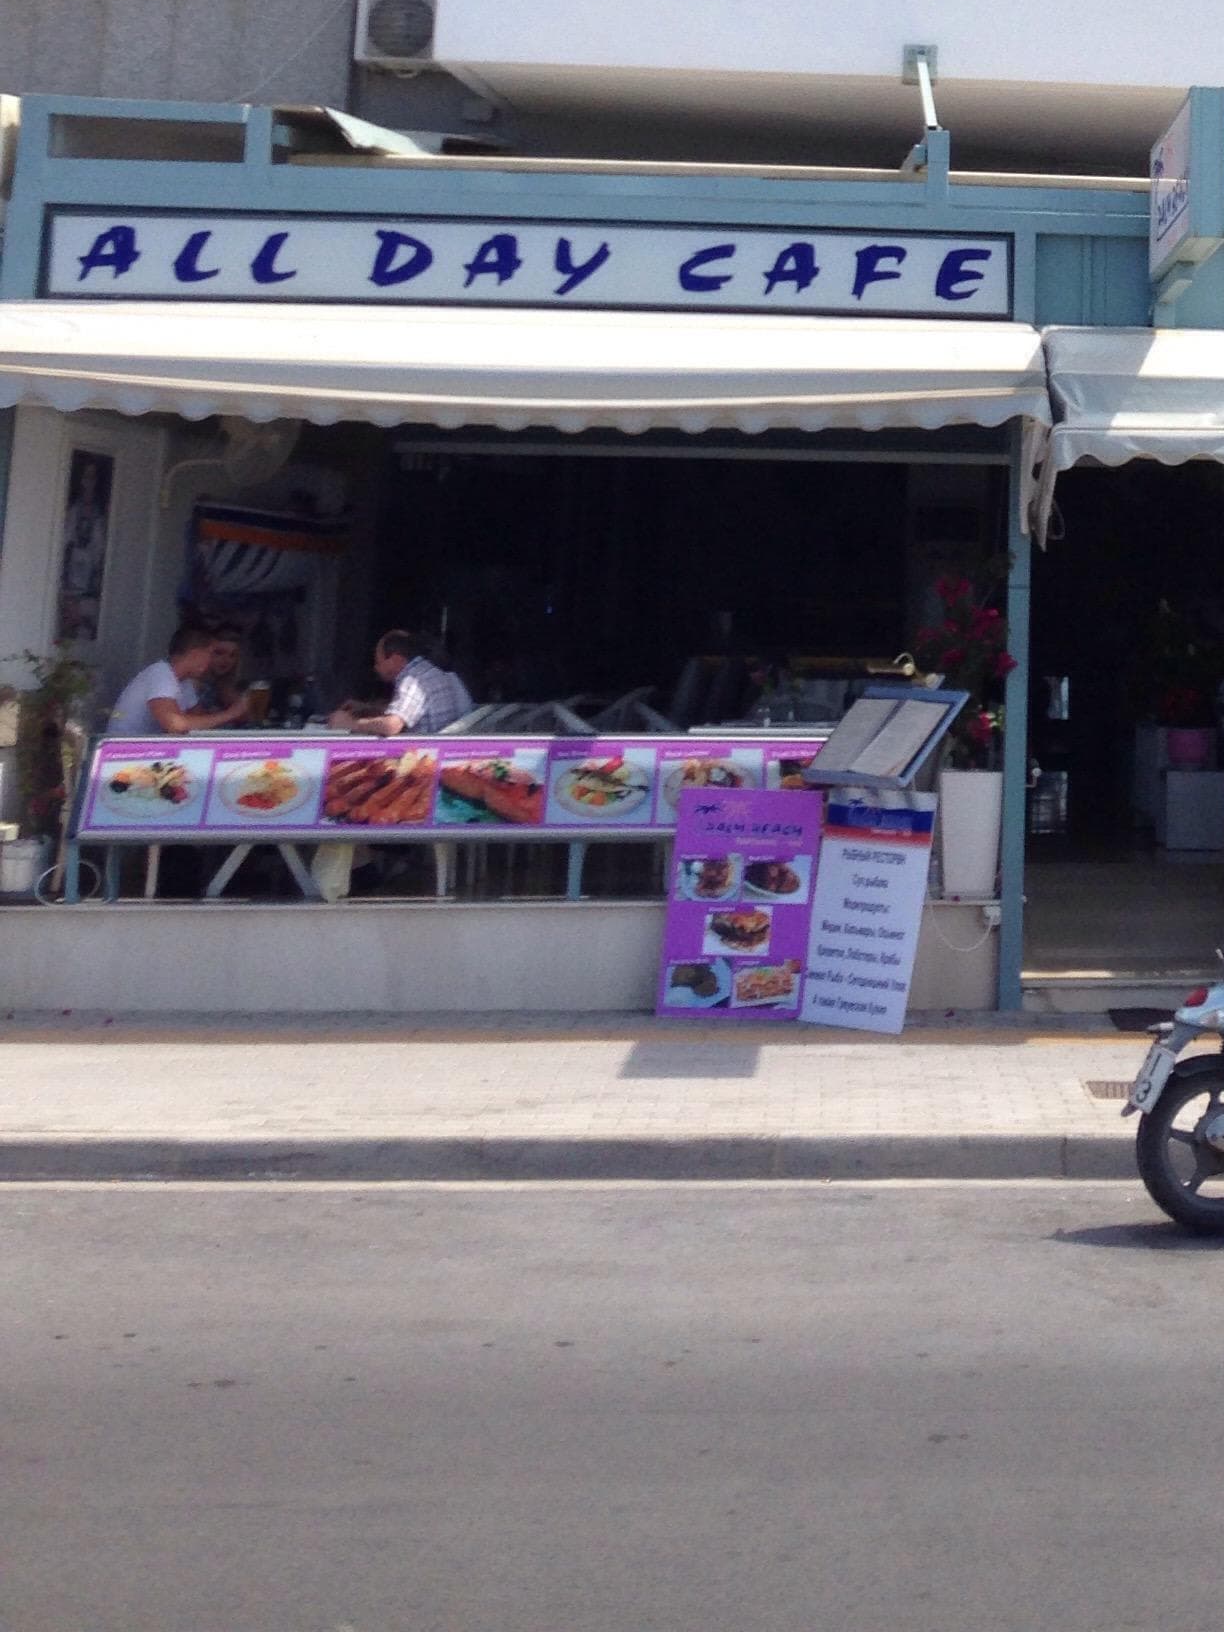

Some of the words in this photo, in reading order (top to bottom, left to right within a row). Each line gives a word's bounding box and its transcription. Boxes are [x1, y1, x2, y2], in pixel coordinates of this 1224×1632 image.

[78, 224, 297, 285] ALL
[370, 229, 609, 295] DAY
[678, 241, 992, 301] CAFE
